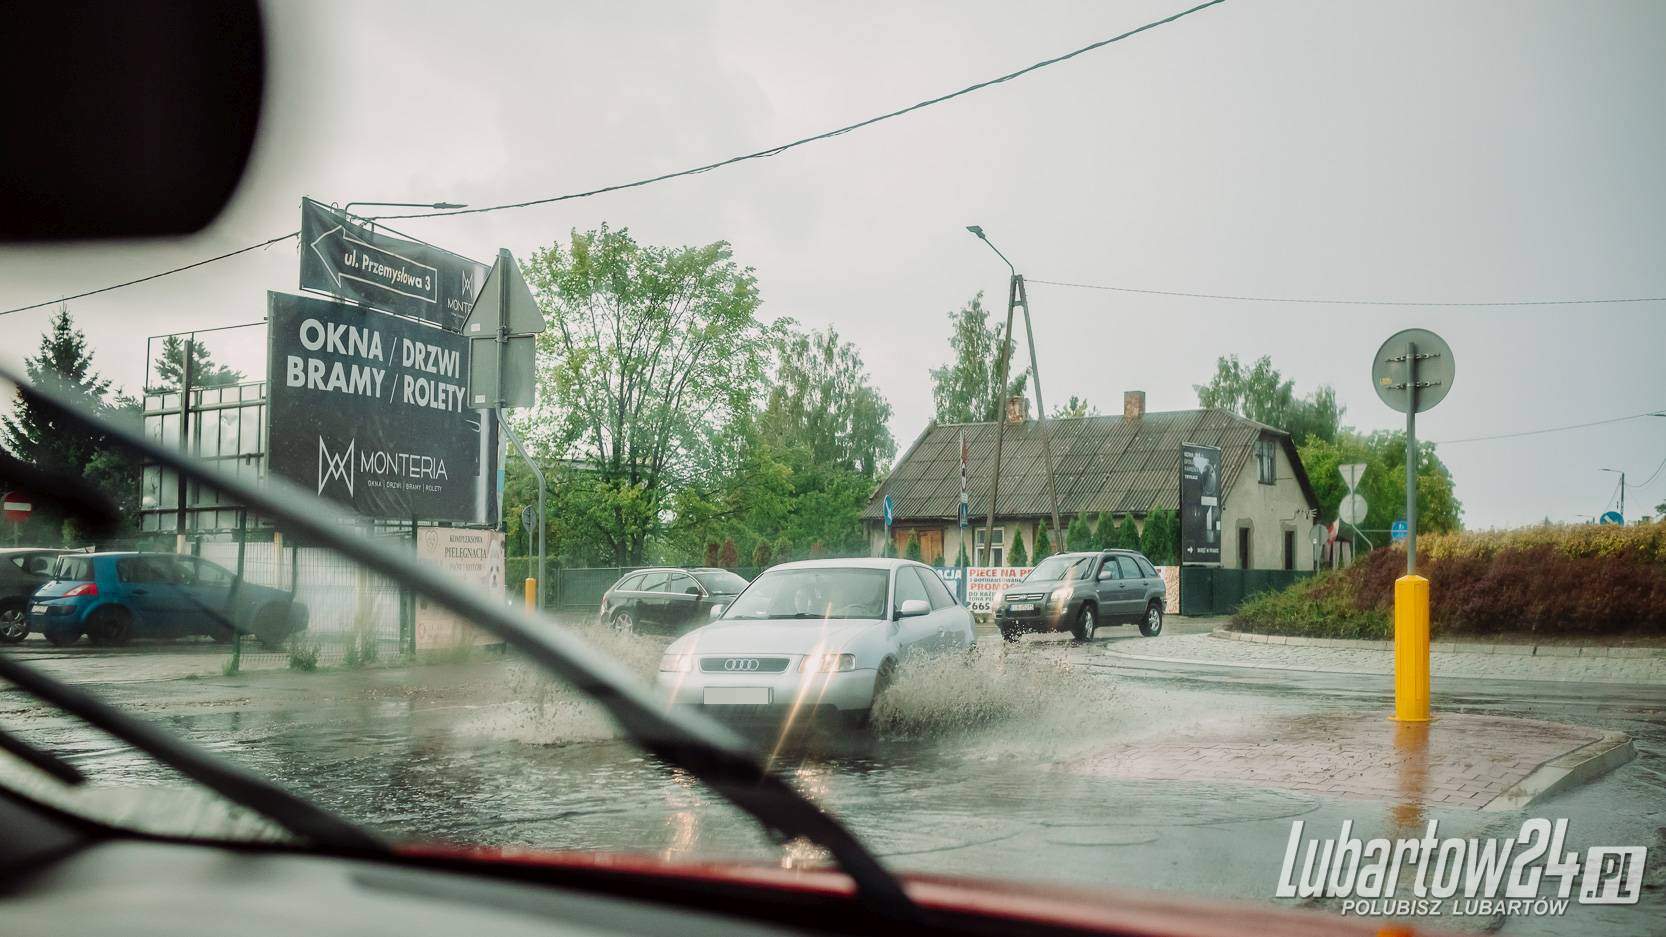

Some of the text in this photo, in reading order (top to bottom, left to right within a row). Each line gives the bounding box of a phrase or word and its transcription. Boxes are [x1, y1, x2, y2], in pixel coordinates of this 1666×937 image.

[344, 249, 431, 291] ul. Przemysłowa 3
[447, 297, 474, 315] MONTE
[299, 318, 384, 361] OKNA
[402, 338, 460, 379] DRZWI
[286, 355, 386, 398] BRAMY
[403, 374, 466, 414] ROLETY
[360, 450, 448, 480] MONTERIA
[969, 568, 997, 577] PIECE
[1001, 569, 1017, 577] NA
